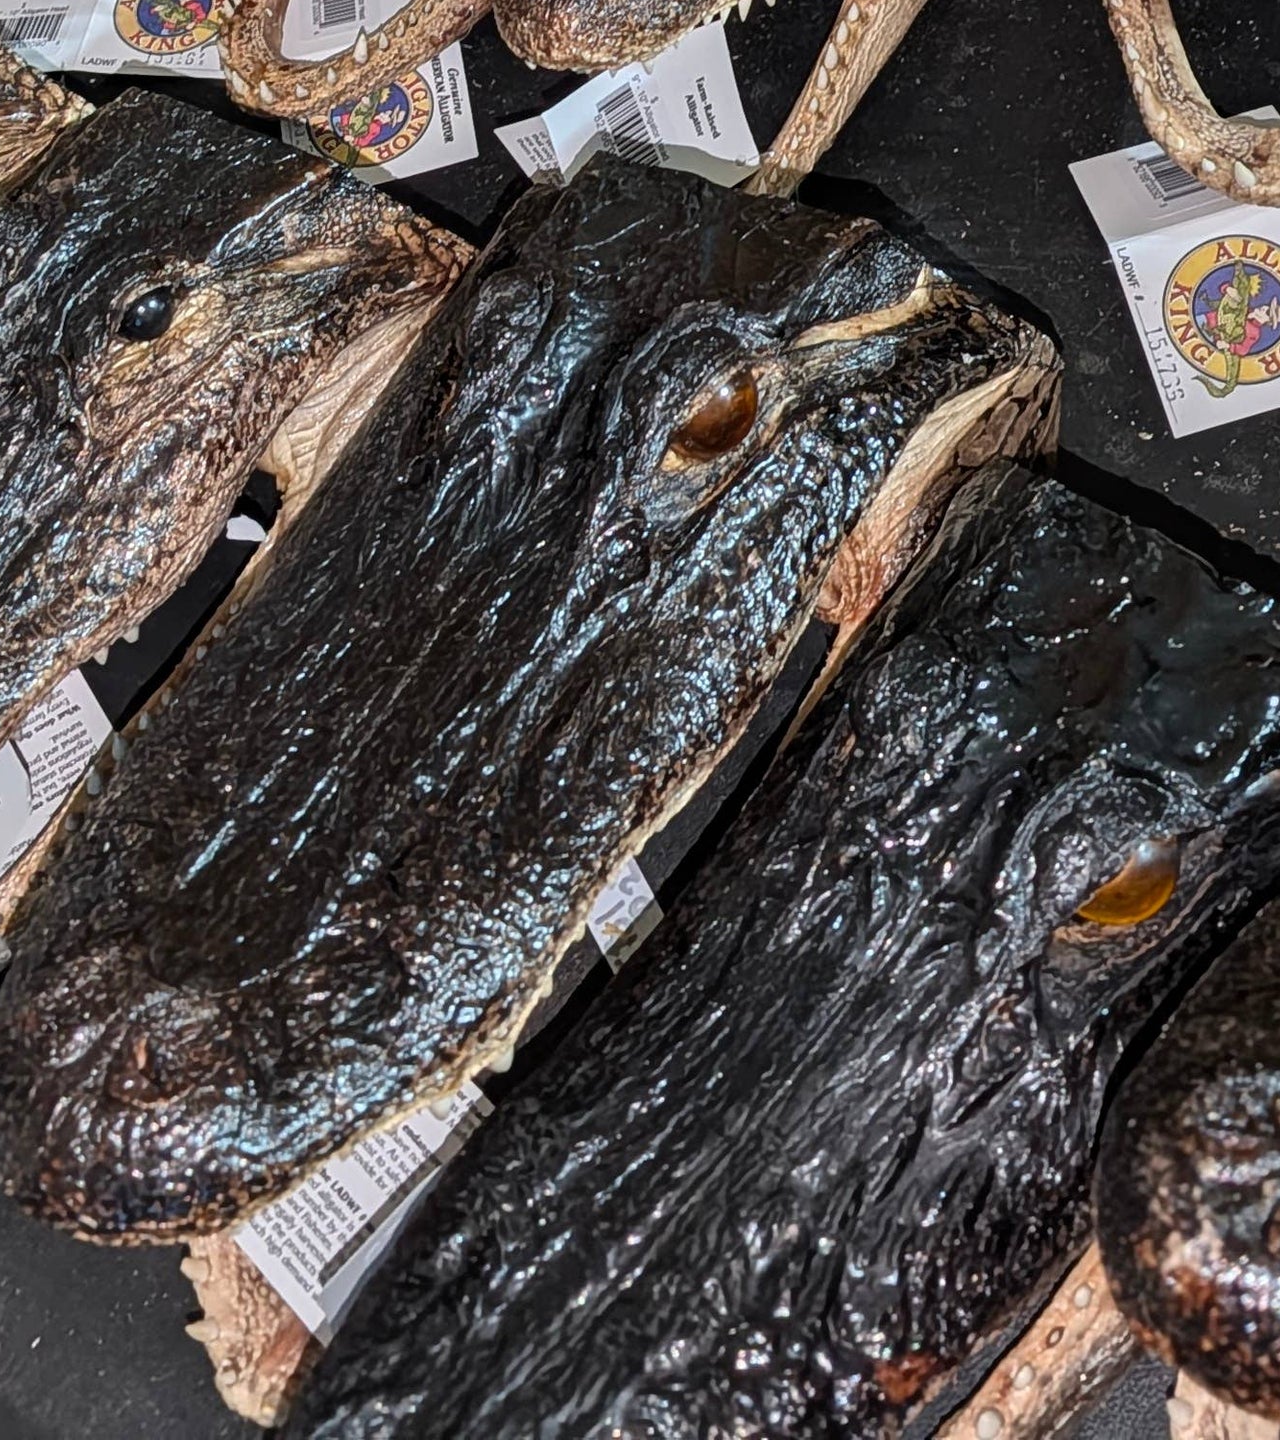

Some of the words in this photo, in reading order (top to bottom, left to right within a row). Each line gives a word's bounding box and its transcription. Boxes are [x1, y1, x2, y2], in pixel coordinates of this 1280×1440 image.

[129, 30, 196, 51] KING
[447, 68, 462, 116] Genuine
[439, 94, 454, 144] ALLIGATOR
[684, 94, 704, 137] Alligator
[1116, 246, 1140, 291] LADWF
[1169, 281, 1215, 366] KING
